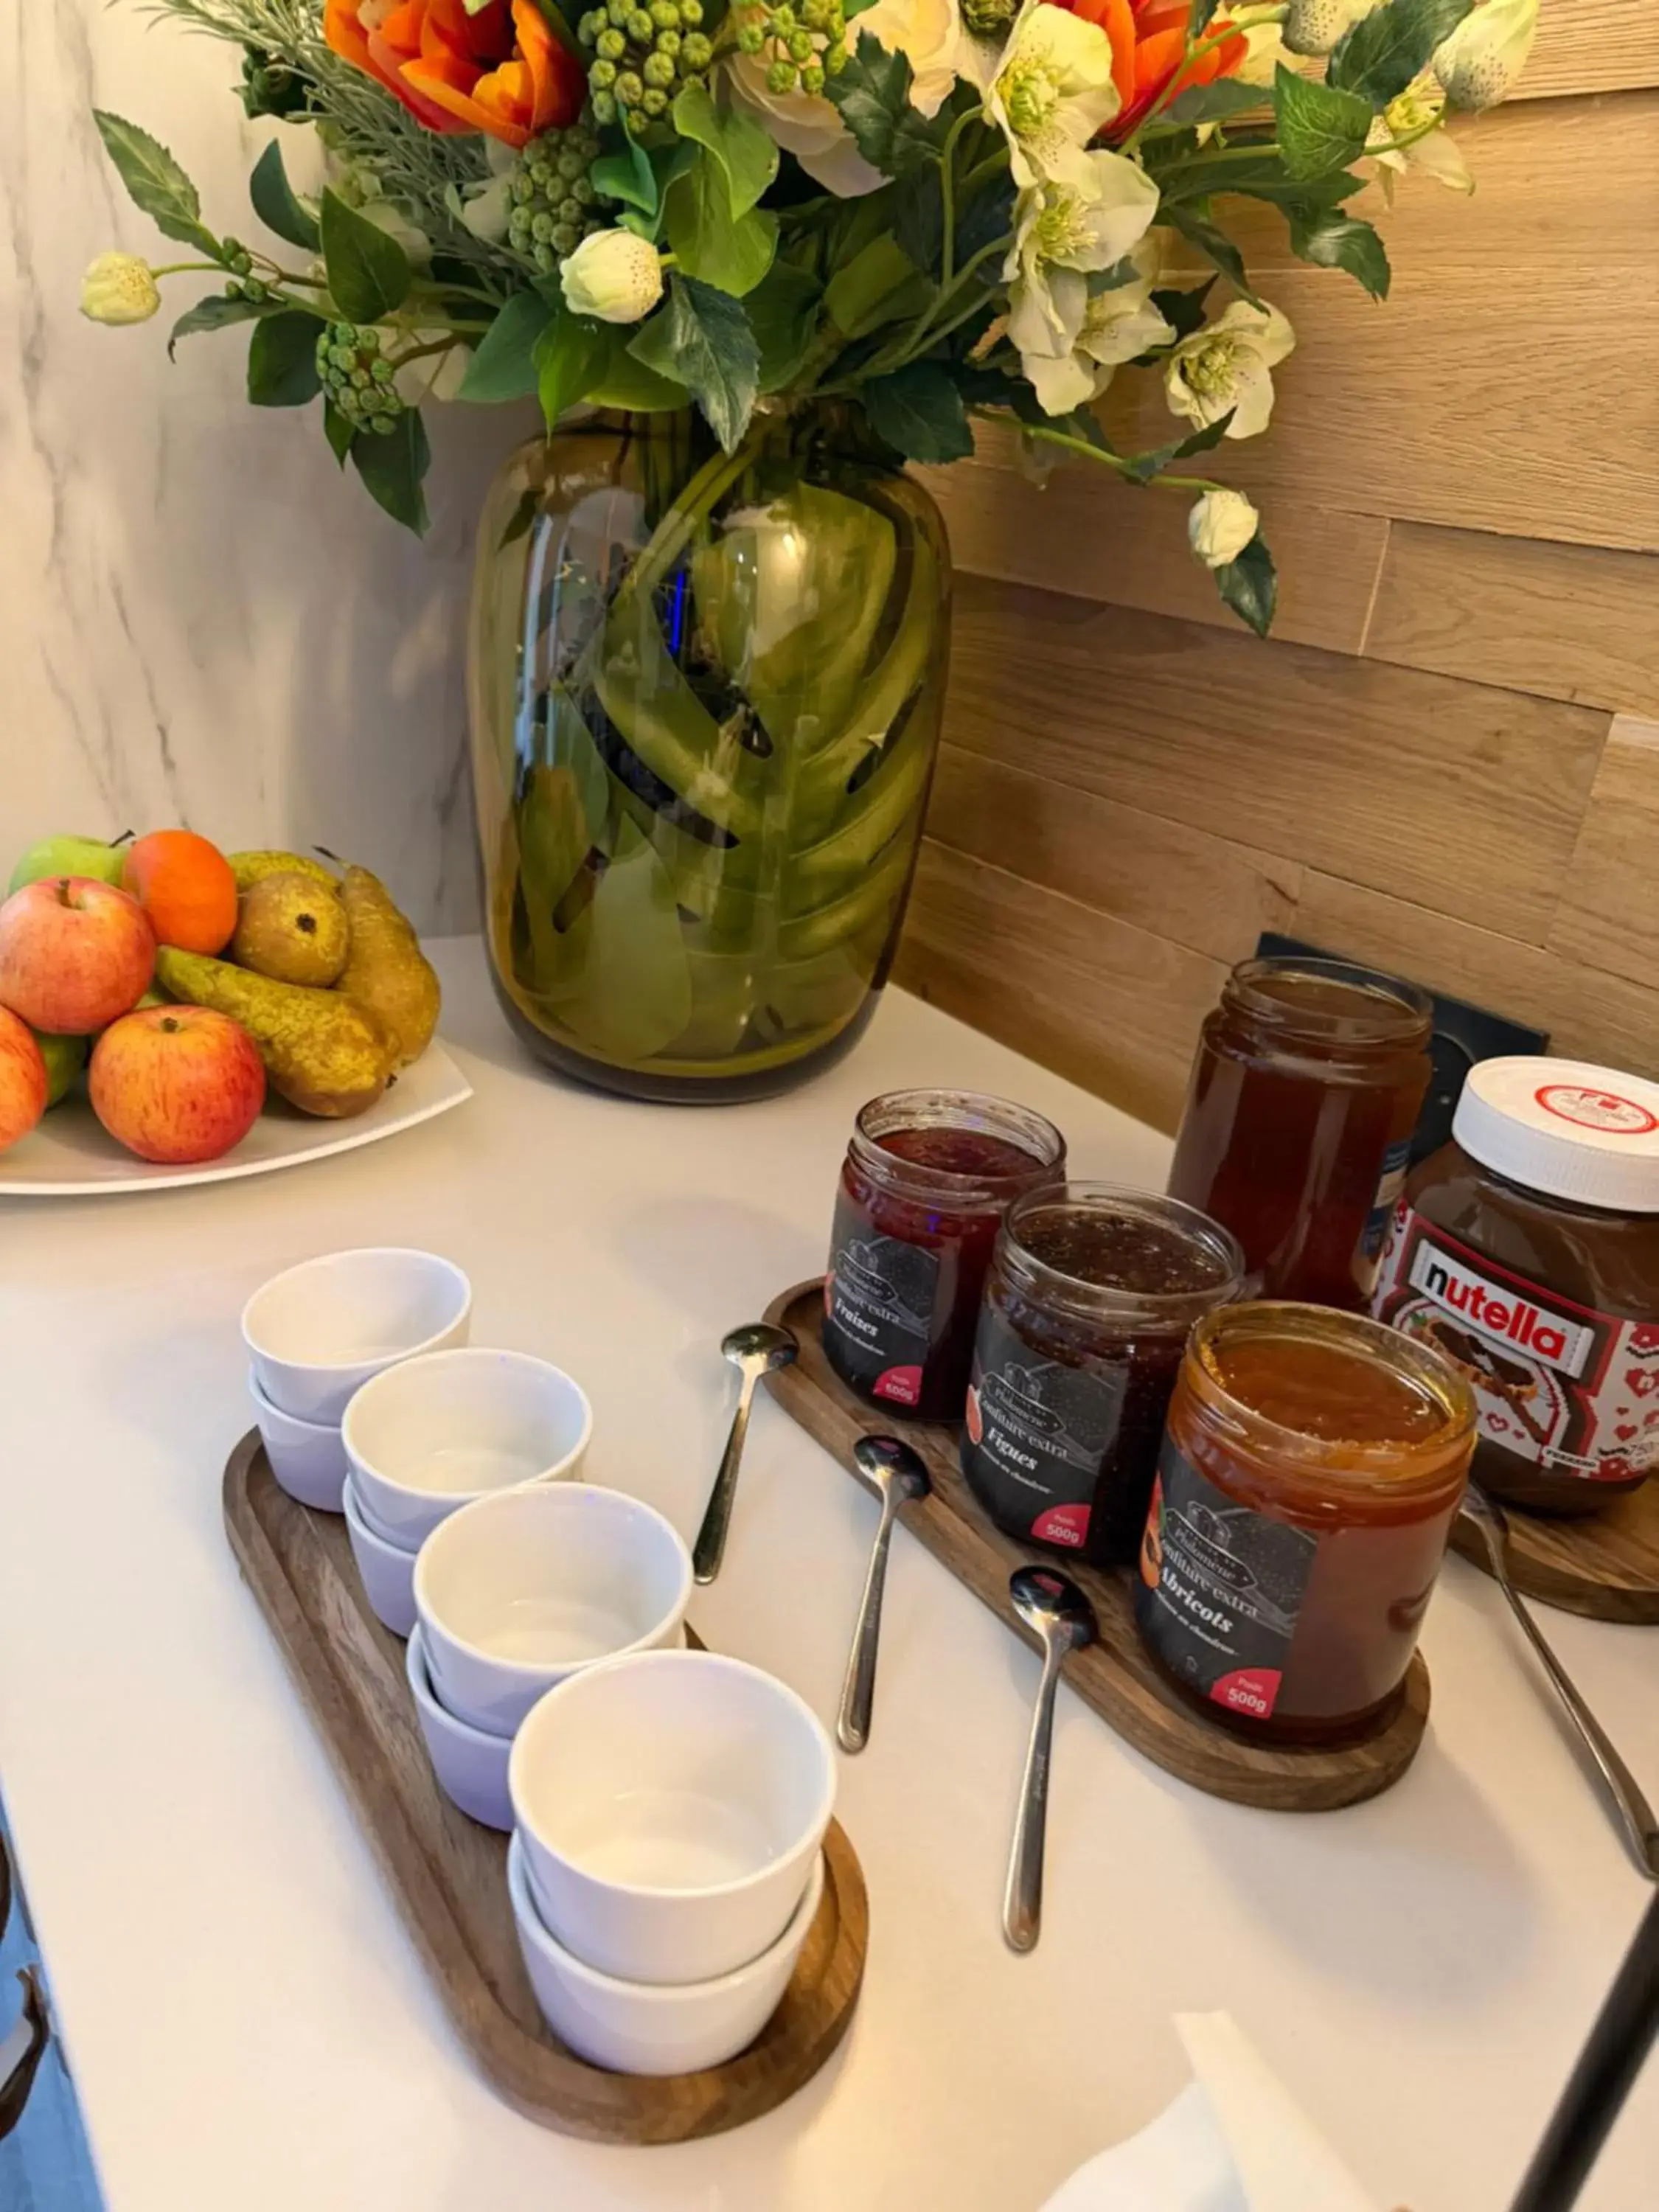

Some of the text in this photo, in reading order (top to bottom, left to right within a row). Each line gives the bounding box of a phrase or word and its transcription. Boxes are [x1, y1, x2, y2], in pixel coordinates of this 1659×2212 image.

[835, 1298, 879, 1338] Fraises
[1425, 1262, 1566, 1360] nutella
[988, 1427, 1038, 1470] Figues
[1029, 1435, 1068, 1458] extra
[1046, 1523, 1079, 1543] 500g
[1213, 1588, 1259, 1618] extra
[1227, 1688, 1266, 1711] 500g
